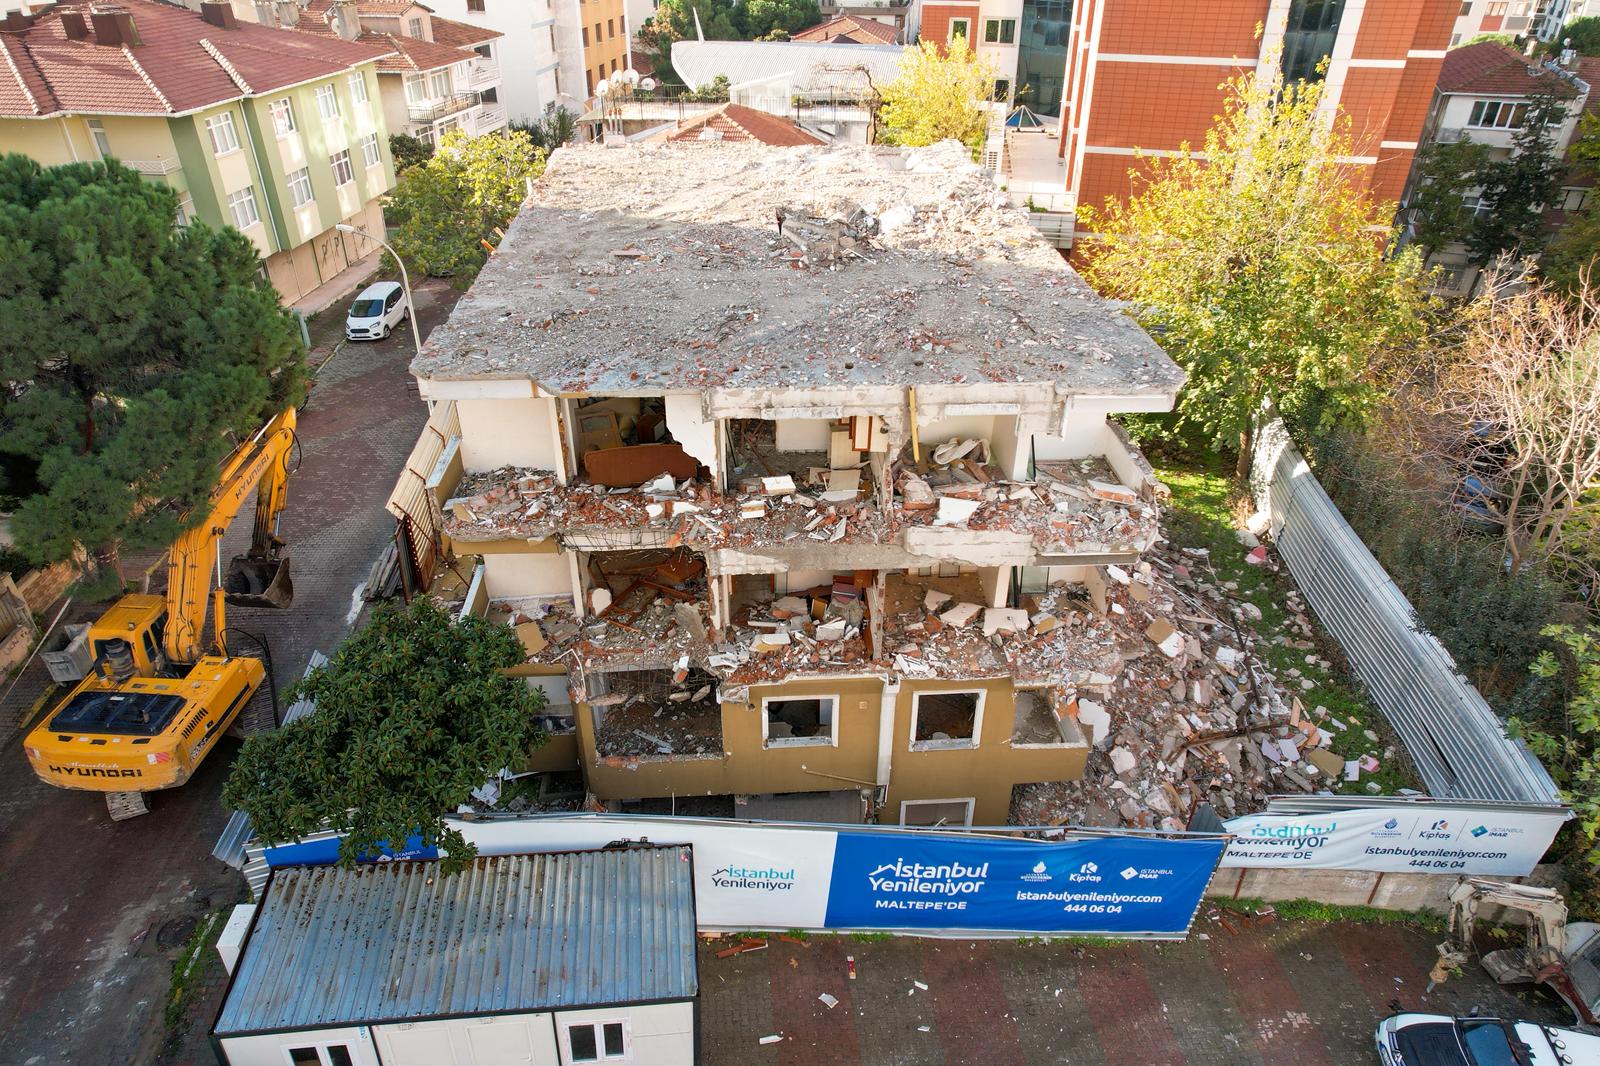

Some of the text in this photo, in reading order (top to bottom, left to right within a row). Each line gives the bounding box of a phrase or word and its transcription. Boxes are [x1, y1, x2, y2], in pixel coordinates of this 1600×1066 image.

[235, 453, 269, 499] HYUNDAI
[49, 764, 144, 777] HYUNDAI
[1418, 831, 1451, 841] Kiptaş
[1226, 850, 1313, 860] MALTEPE'DE
[1364, 846, 1508, 860] istanbulyenileniyor.com
[1408, 859, 1431, 867] 444
[1433, 860, 1448, 868] 06
[711, 877, 794, 891] Yenileniyor
[868, 876, 985, 896] Yenileniyor
[1016, 891, 1163, 904] istanbulyenileniyor.com
[875, 900, 968, 910] MALTEPE'DE
[1063, 904, 1122, 913] 444 06 04
